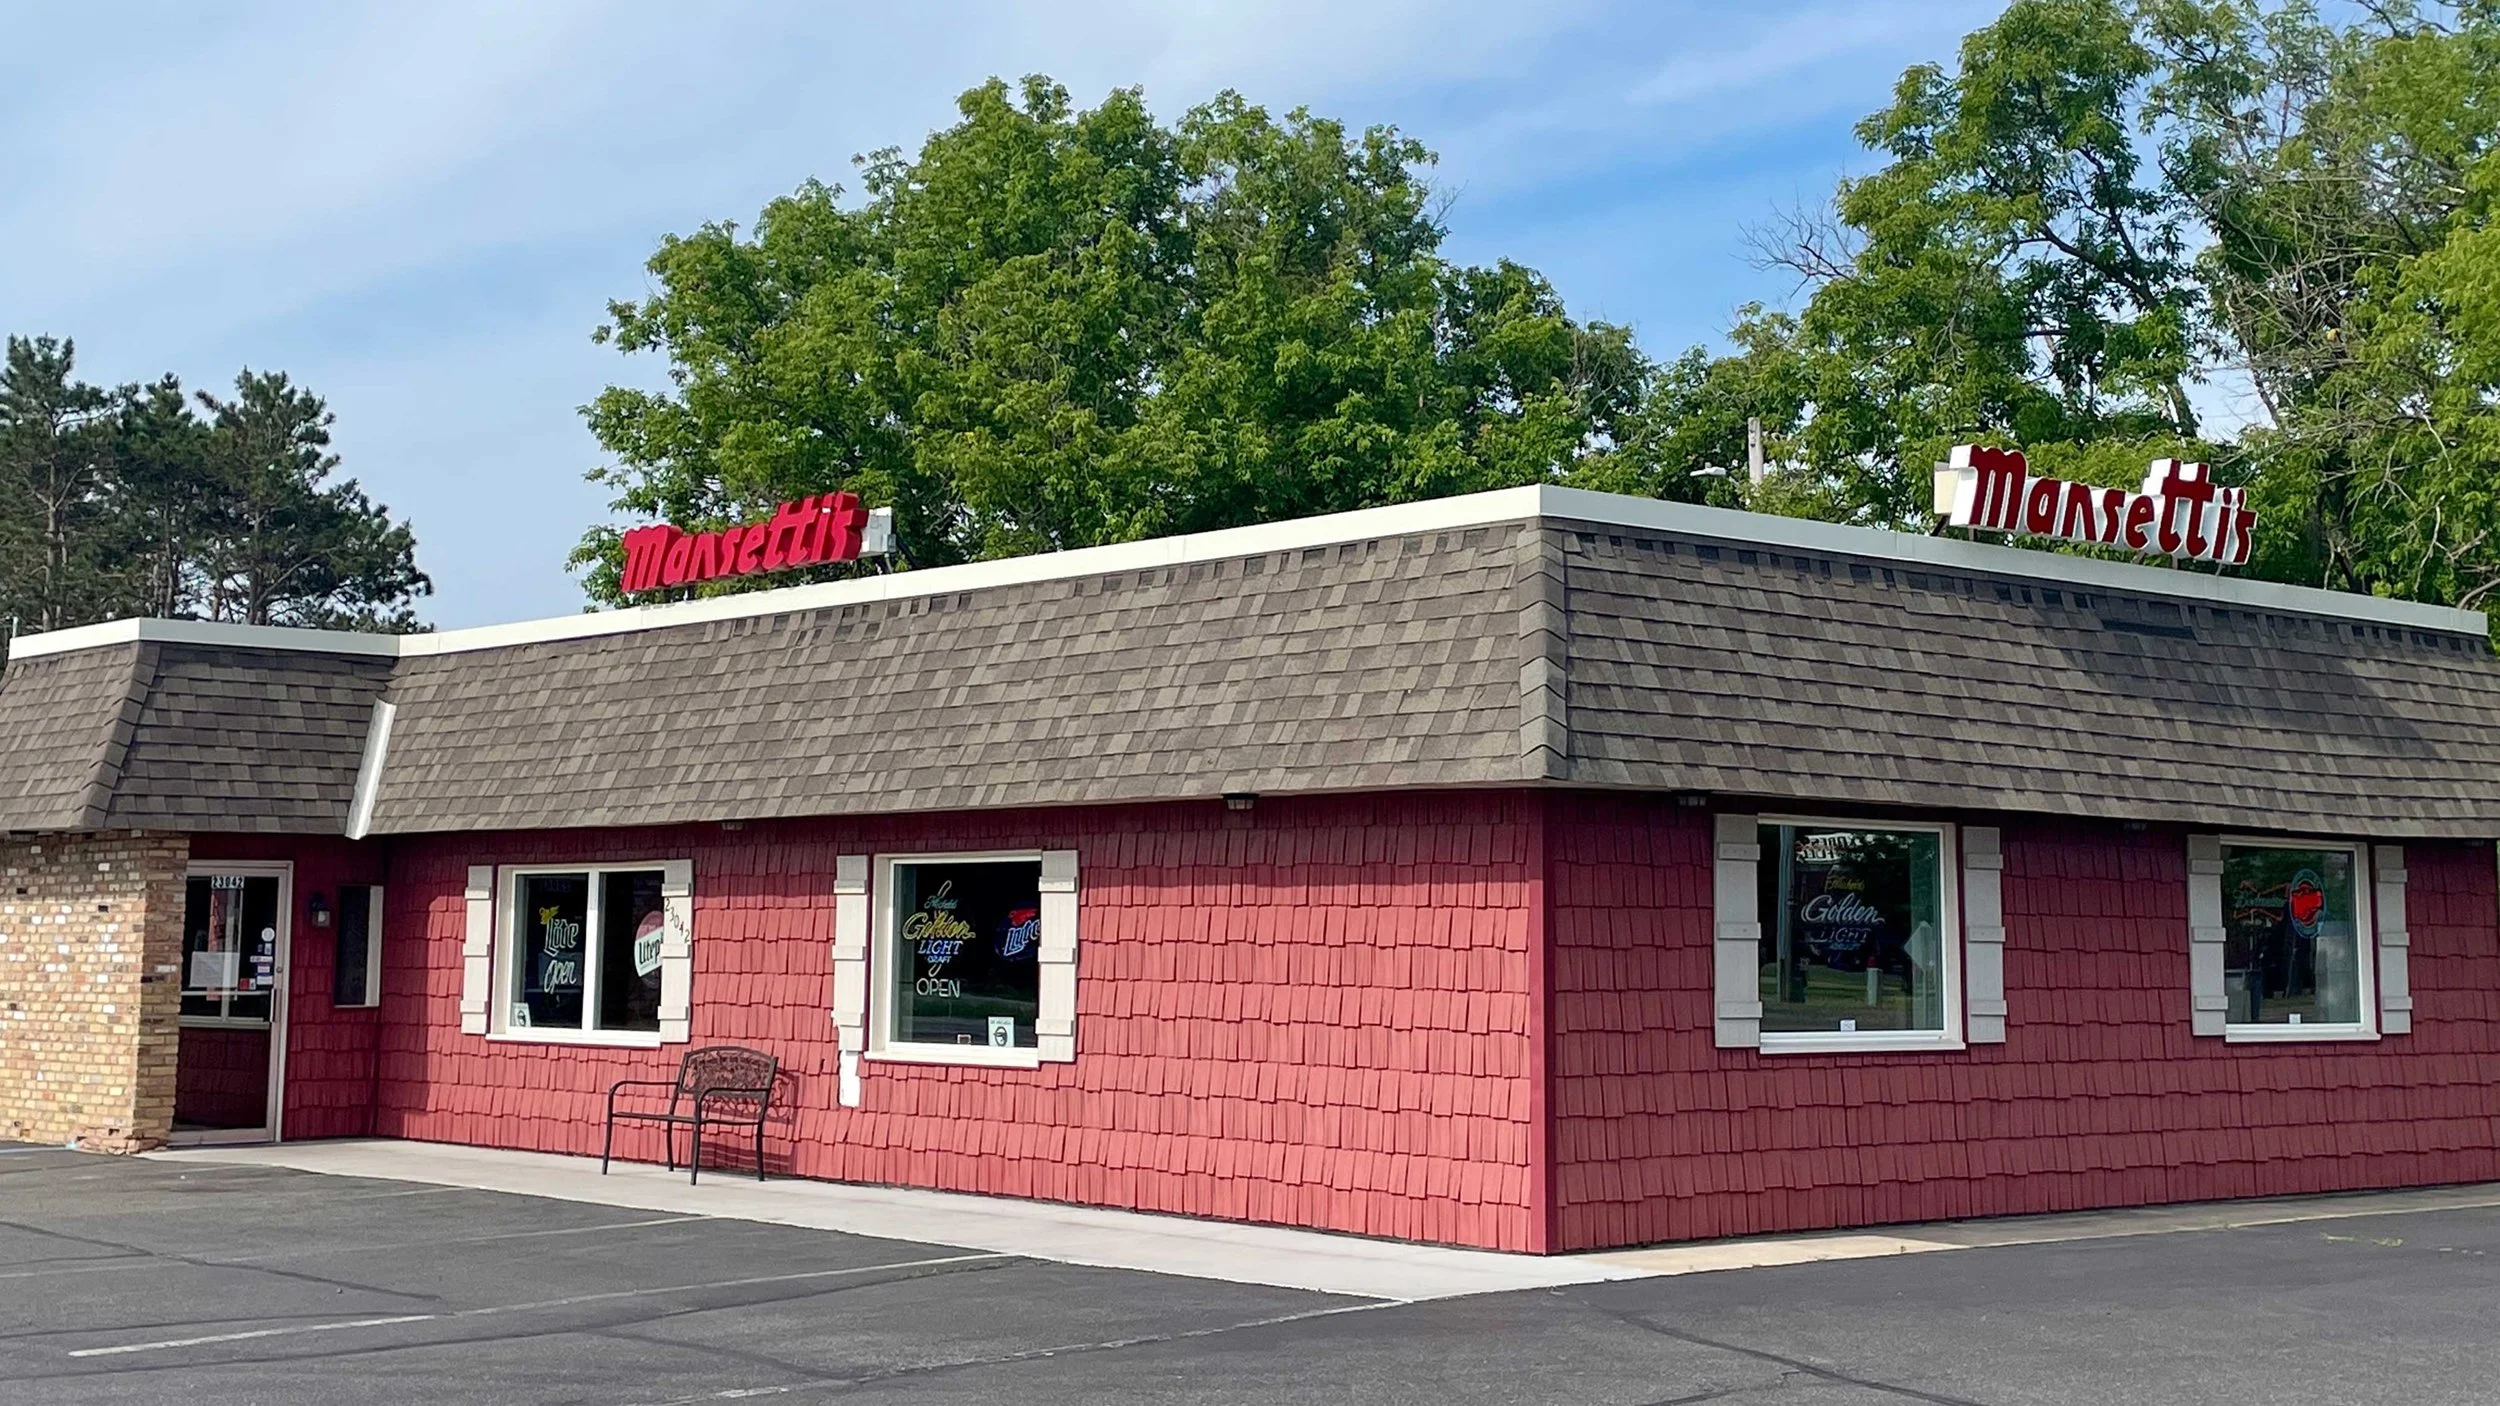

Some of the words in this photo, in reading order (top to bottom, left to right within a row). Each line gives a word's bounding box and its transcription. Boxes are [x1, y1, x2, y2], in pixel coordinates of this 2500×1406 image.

[213, 876, 242, 888] 23042
[664, 897, 690, 944] 23042
[1801, 893, 1886, 924] Golden
[543, 917, 580, 957] Lite
[903, 911, 976, 940] Golden
[917, 940, 963, 955] LIGHT
[916, 977, 961, 998] OPEN
